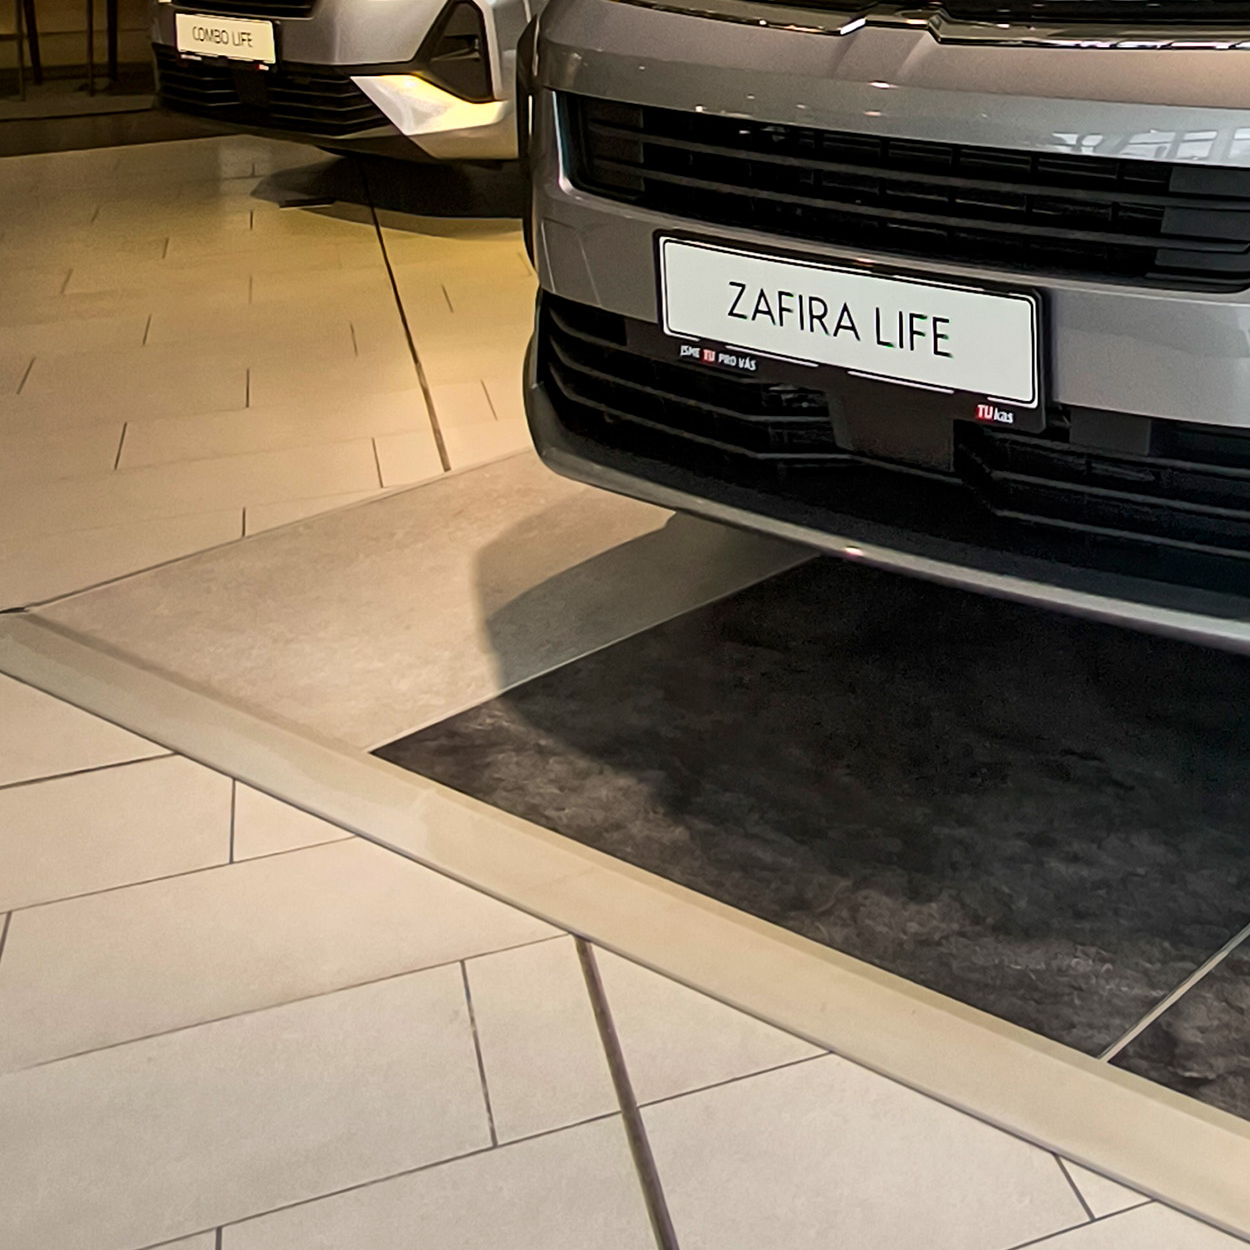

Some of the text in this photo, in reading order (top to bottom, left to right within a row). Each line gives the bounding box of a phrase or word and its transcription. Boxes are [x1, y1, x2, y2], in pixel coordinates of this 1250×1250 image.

[192, 26, 253, 48] COMBO LIFE
[727, 281, 953, 358] ZAFIRA LIFE
[703, 349, 716, 362] TU
[718, 353, 737, 366] PRO
[738, 356, 756, 370] VÁS
